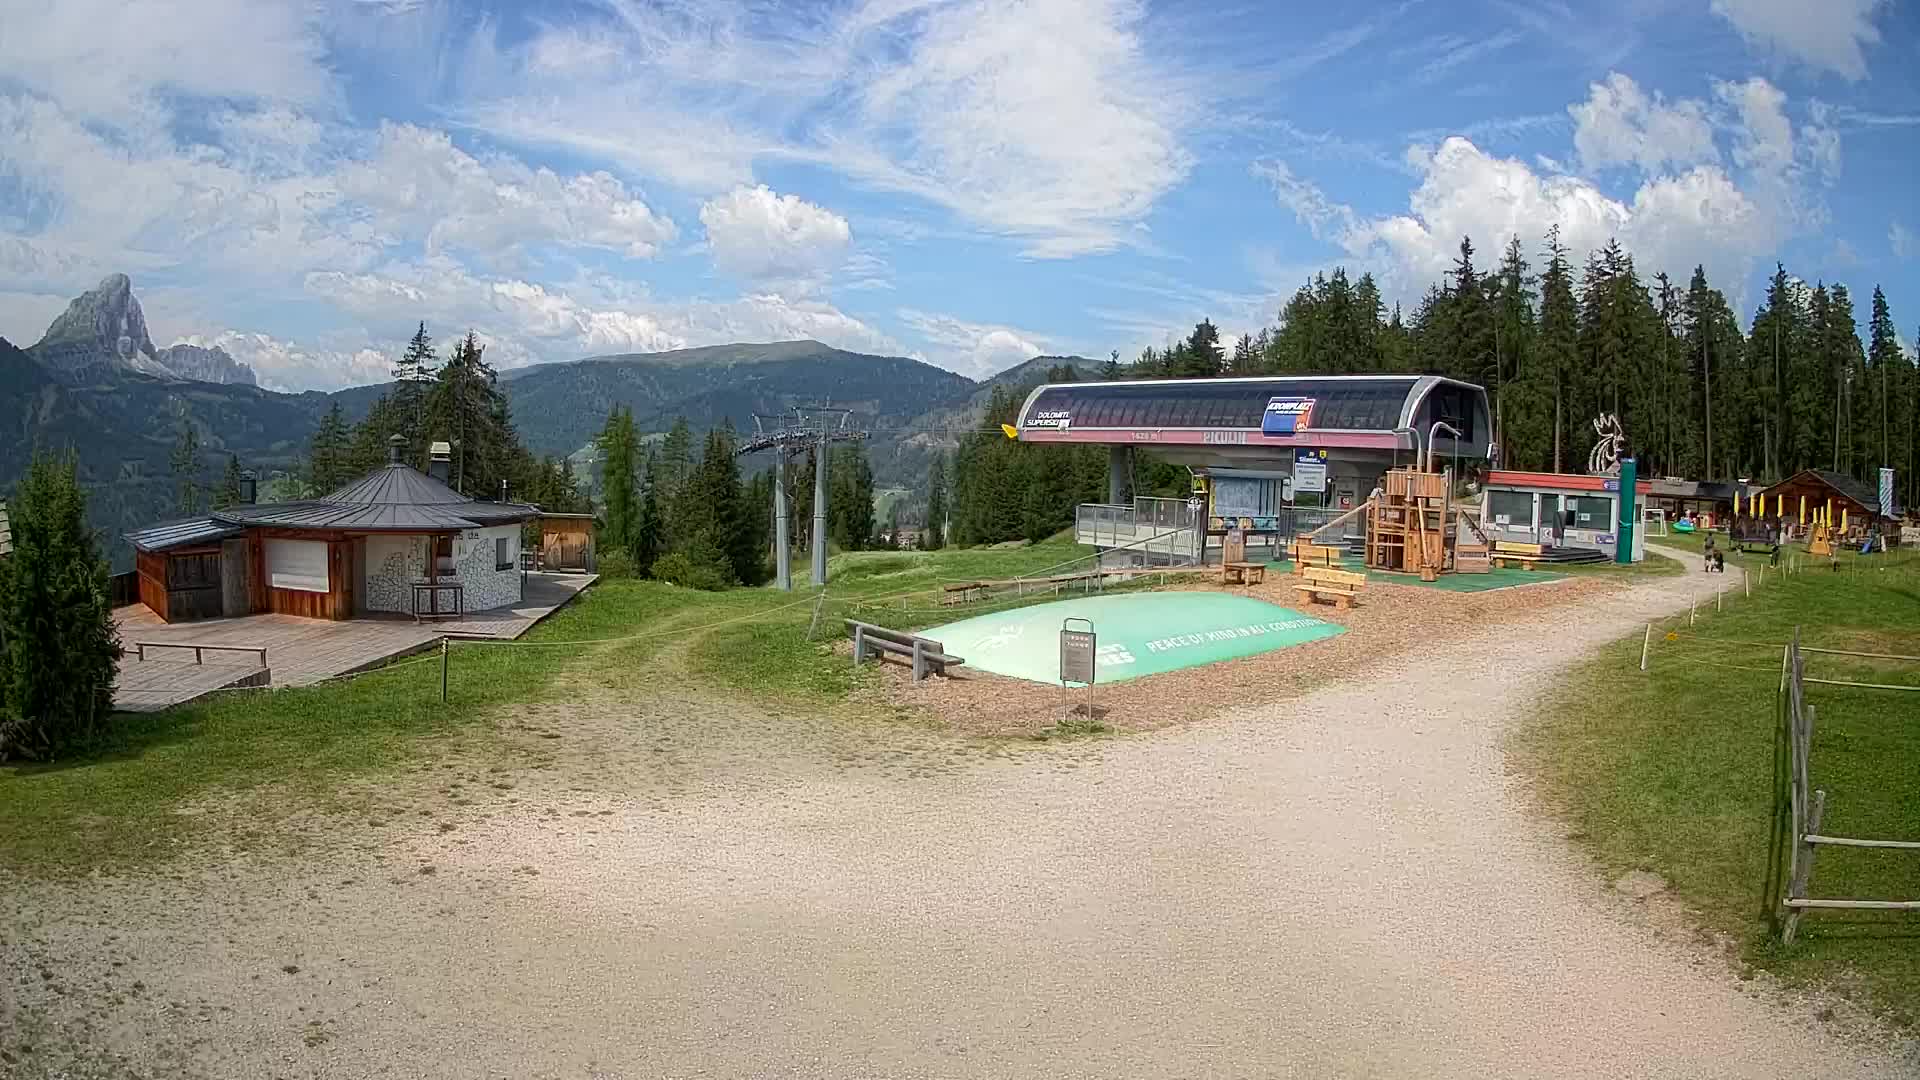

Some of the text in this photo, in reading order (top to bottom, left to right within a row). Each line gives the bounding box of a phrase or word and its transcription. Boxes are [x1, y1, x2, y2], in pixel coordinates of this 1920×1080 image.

[1037, 411, 1070, 419] DOLOMITI
[1203, 431, 1247, 445] PICULIN
[1144, 635, 1191, 653] PEACE
[1188, 632, 1205, 645] OF
[1205, 628, 1237, 642] MIND
[1236, 626, 1251, 638] IN
